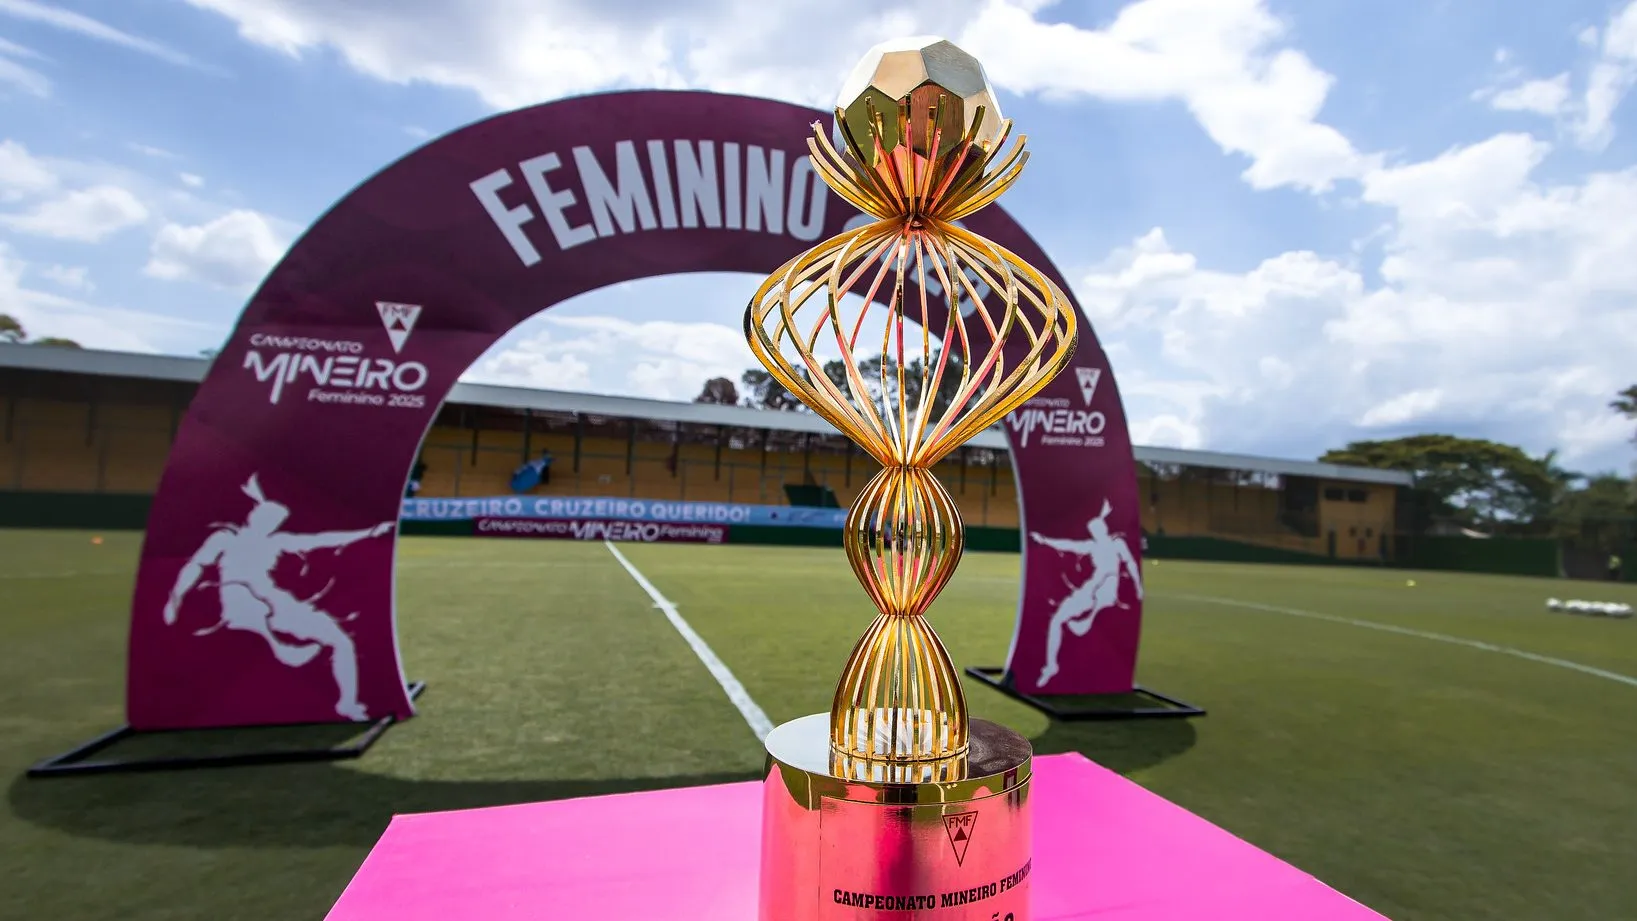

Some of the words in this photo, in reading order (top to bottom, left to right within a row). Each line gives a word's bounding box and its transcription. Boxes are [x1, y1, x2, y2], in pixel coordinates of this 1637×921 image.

[469, 139, 828, 267] FEMININO
[250, 333, 363, 353] CAMPEONATO
[243, 350, 429, 404] MINEIRO
[307, 388, 384, 405] Feminino
[387, 394, 425, 408] 2025
[1006, 409, 1106, 448] MINEIRO
[534, 499, 646, 518] CRUZEIRO
[651, 502, 751, 522] QUERIDO!
[569, 519, 660, 541] MINEIRO
[948, 815, 973, 829] FMF
[833, 888, 936, 911] CAMPEONATO
[940, 882, 998, 909] MINEIRO
